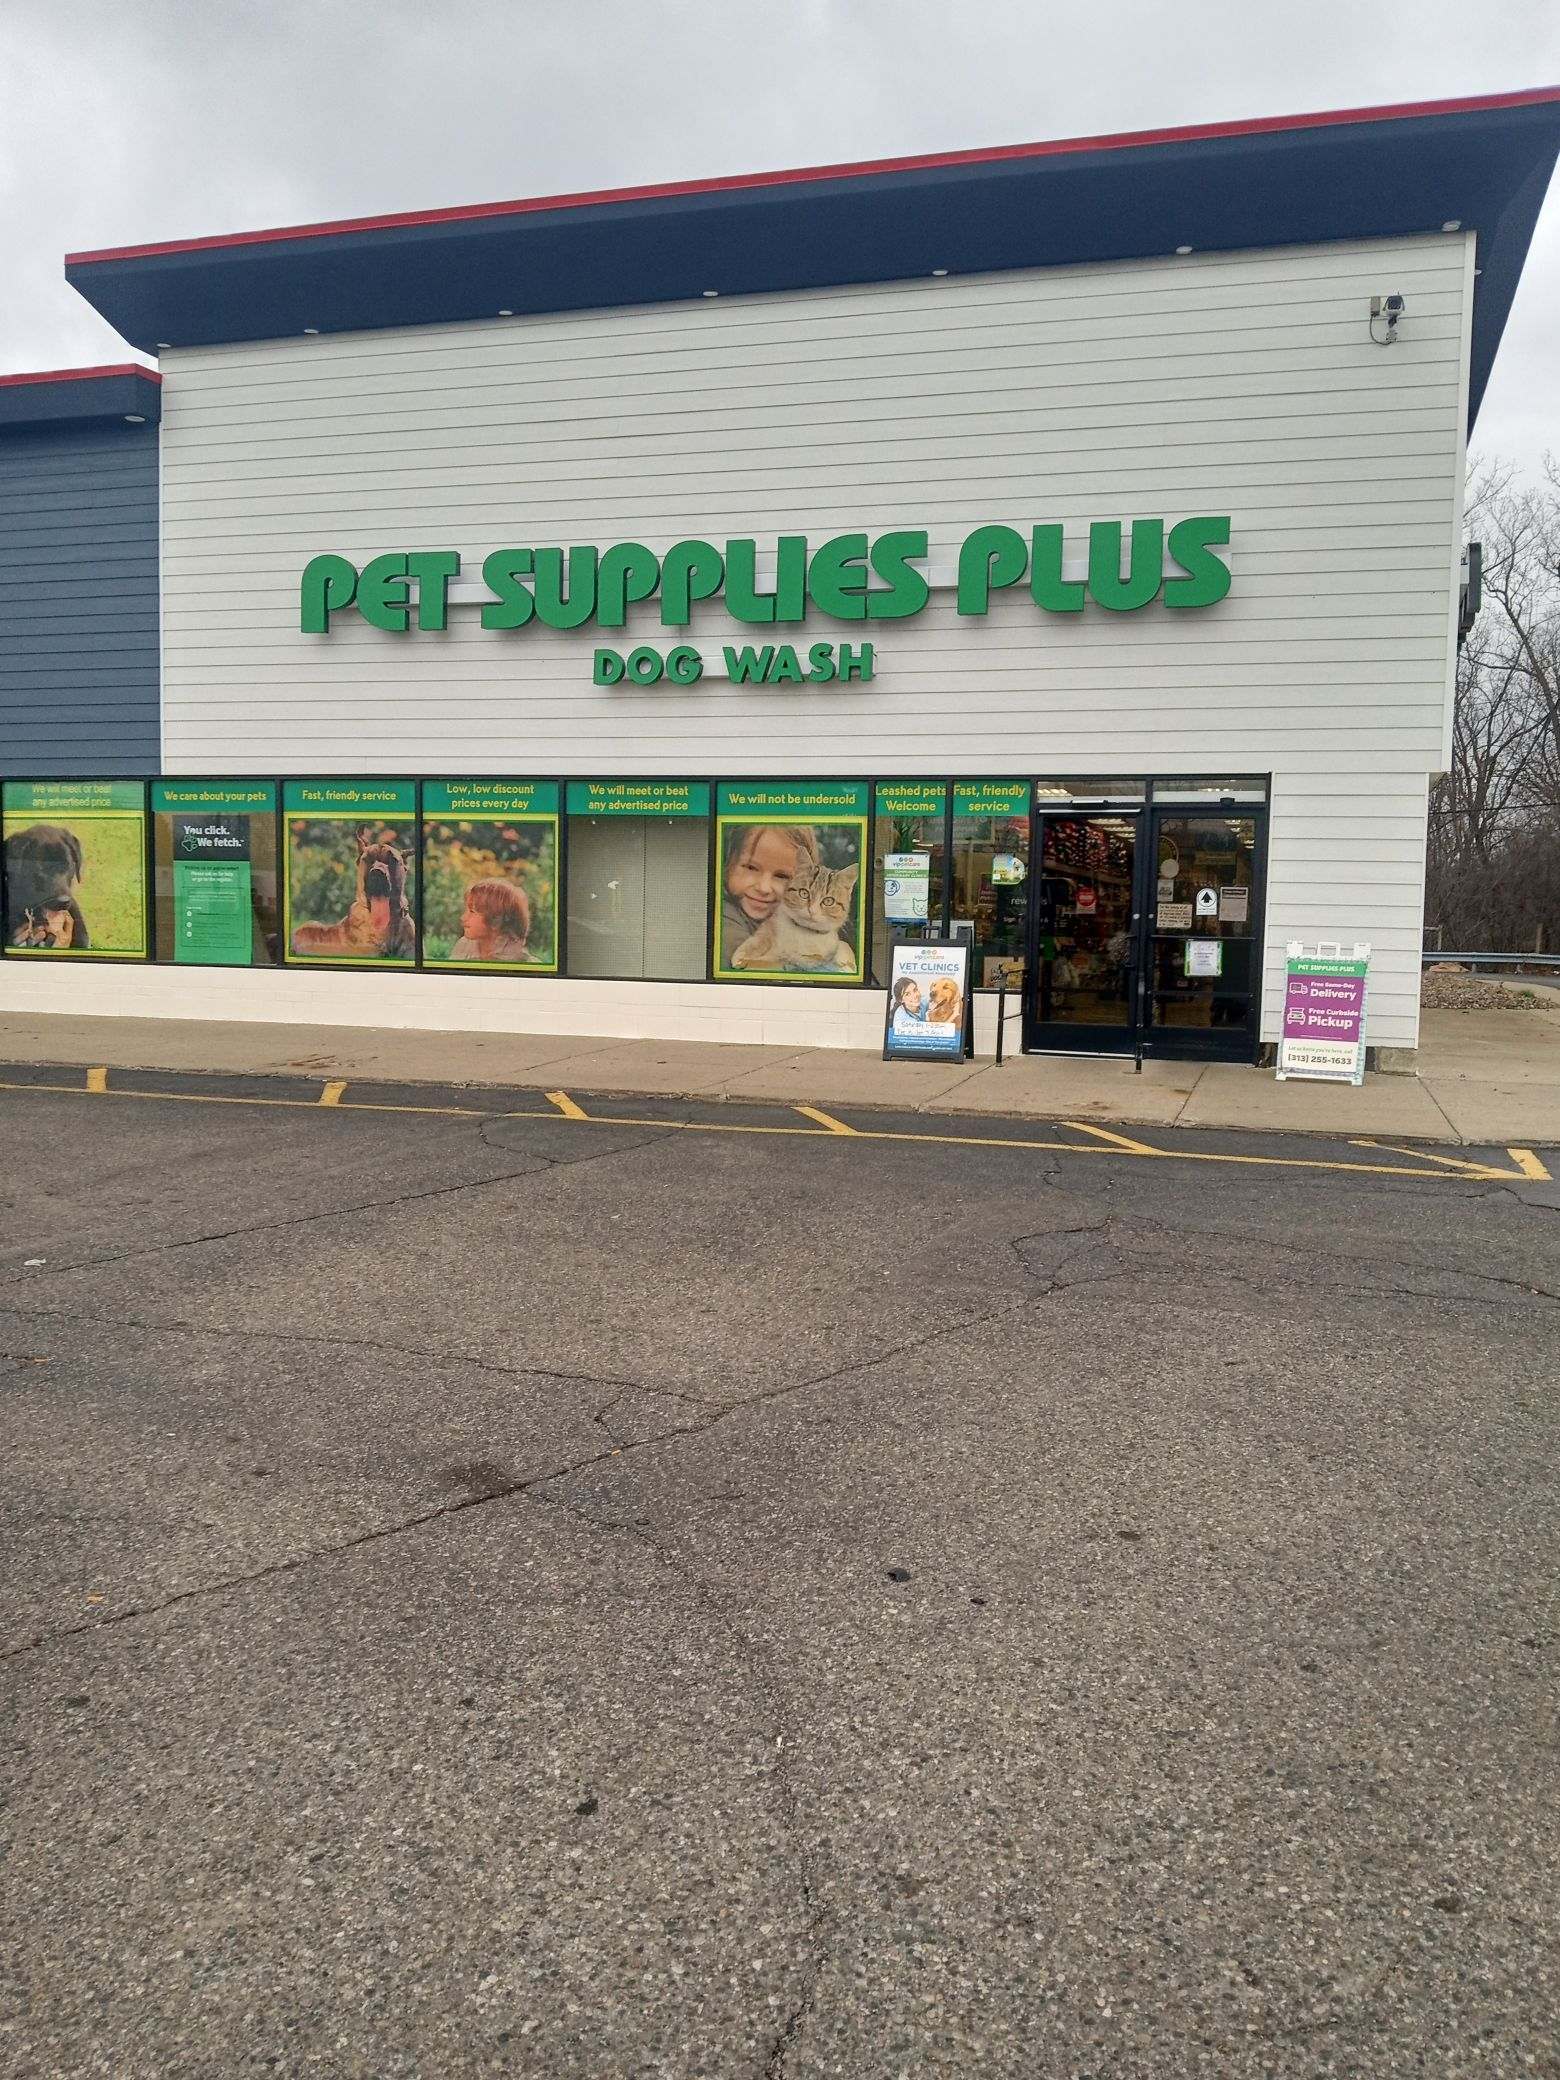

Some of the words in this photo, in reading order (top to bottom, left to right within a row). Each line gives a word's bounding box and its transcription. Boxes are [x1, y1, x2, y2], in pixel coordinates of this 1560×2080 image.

[301, 551, 461, 633] PET
[481, 530, 930, 629] SUPPLIES
[957, 516, 1232, 615] PLUS
[593, 645, 704, 686] DOG
[722, 642, 875, 684] WASH
[446, 783, 471, 796] Low,
[472, 784, 493, 794] low
[493, 784, 535, 794] discount
[589, 784, 606, 795] We
[607, 785, 625, 795] will
[626, 786, 652, 796] meet
[653, 788, 664, 796] or
[666, 786, 689, 796] beat
[876, 784, 921, 796] Leashed
[923, 785, 946, 797] pets
[953, 784, 980, 797] Fast,
[982, 784, 1026, 798] friendly
[164, 791, 178, 800] We
[179, 793, 198, 801] care
[199, 791, 225, 801] about
[225, 793, 246, 803] your
[247, 791, 267, 803] pets
[302, 790, 325, 802] Fast,
[326, 790, 360, 802] friendly
[361, 791, 397, 801] service
[728, 793, 746, 804] We
[747, 793, 767, 804] will
[768, 795, 786, 804] not
[787, 793, 801, 804] be
[802, 793, 856, 805] undersold
[451, 798, 480, 810] prices
[482, 801, 509, 810] every
[511, 799, 529, 810] day
[588, 801, 607, 812] any
[608, 800, 661, 810] advertised
[662, 801, 689, 812] price
[886, 800, 936, 811] Welcome
[968, 801, 1010, 811] service
[183, 825, 203, 835] You
[204, 825, 231, 835] click.
[197, 837, 213, 847] We
[899, 962, 919, 971] VET
[920, 962, 960, 972] CLINICS
[1310, 988, 1357, 1001] Delivery
[1308, 1015, 1353, 1030] Pickup
[1310, 1056, 1352, 1065] 255-1633
